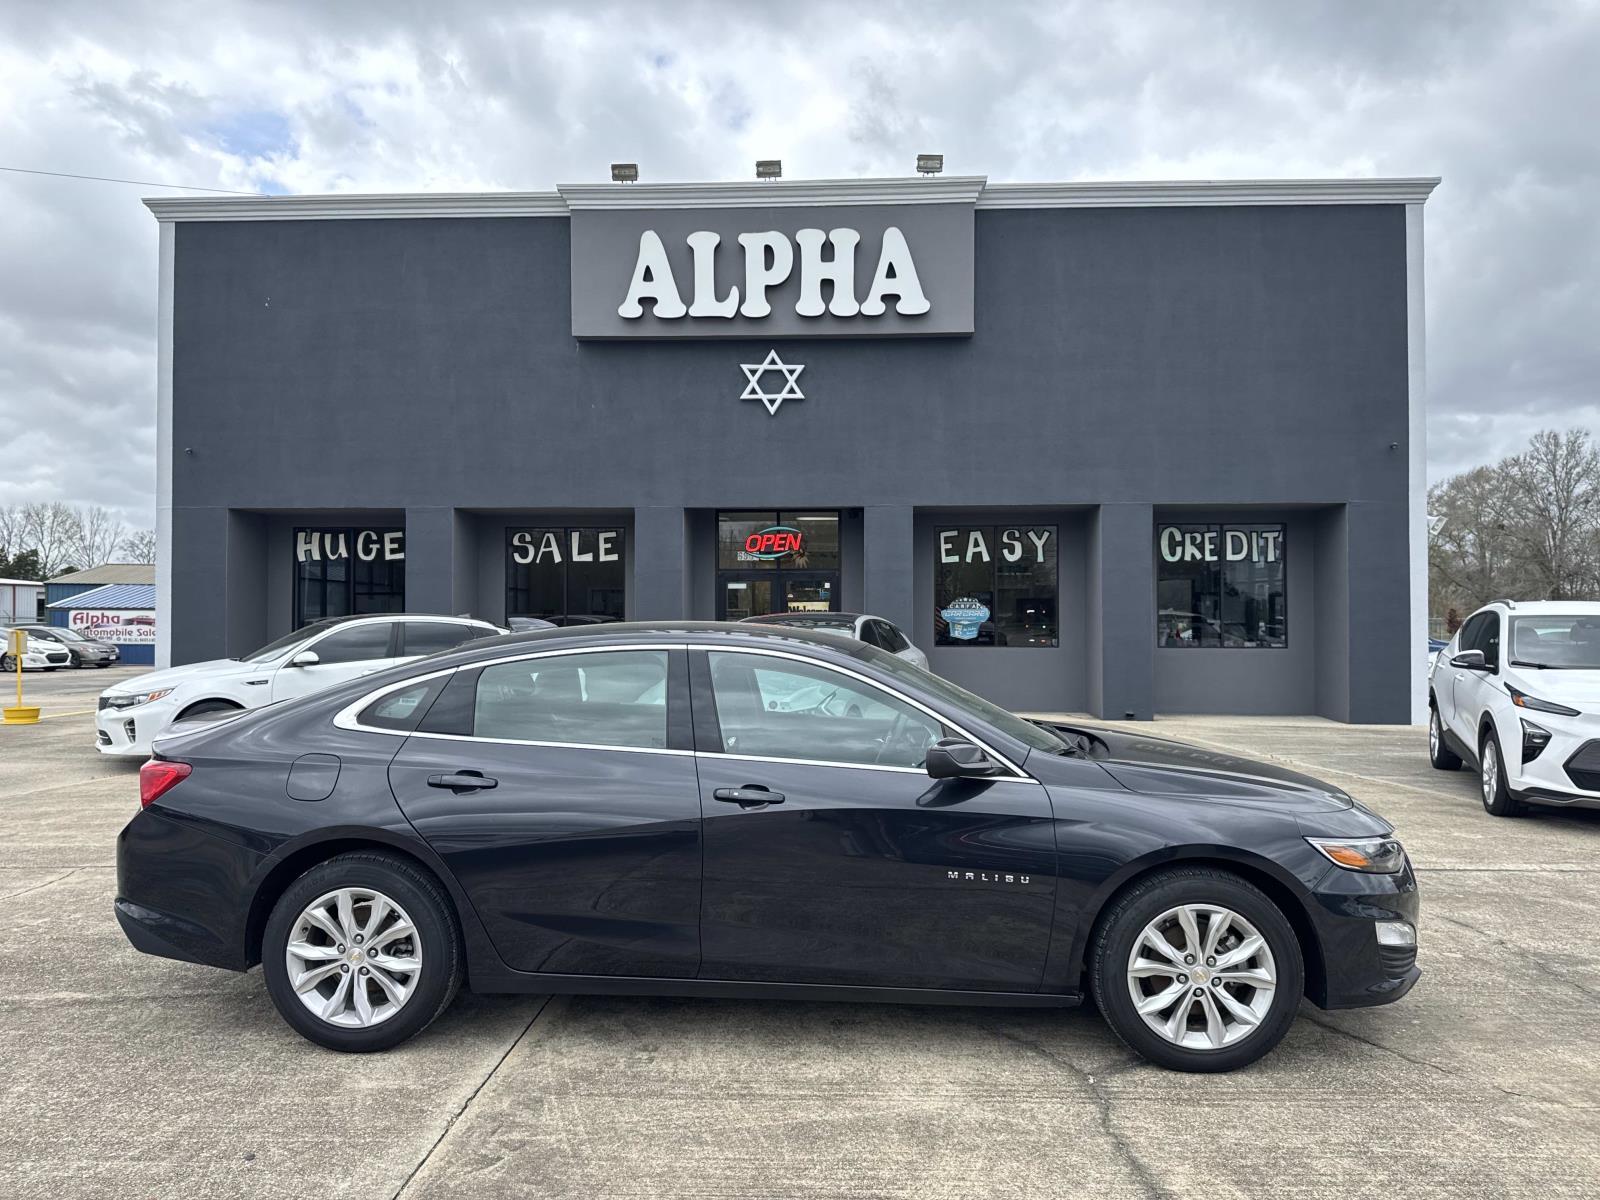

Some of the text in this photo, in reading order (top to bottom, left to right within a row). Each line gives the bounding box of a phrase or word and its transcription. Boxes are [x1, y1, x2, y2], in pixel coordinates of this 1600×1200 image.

[617, 226, 931, 319] ALPHA
[296, 530, 619, 564] HUGE SALE
[745, 533, 802, 551] OPEN
[939, 527, 1280, 564] EASY CREDIT
[72, 612, 121, 627] Alpha
[947, 871, 1030, 884] MALIBU
